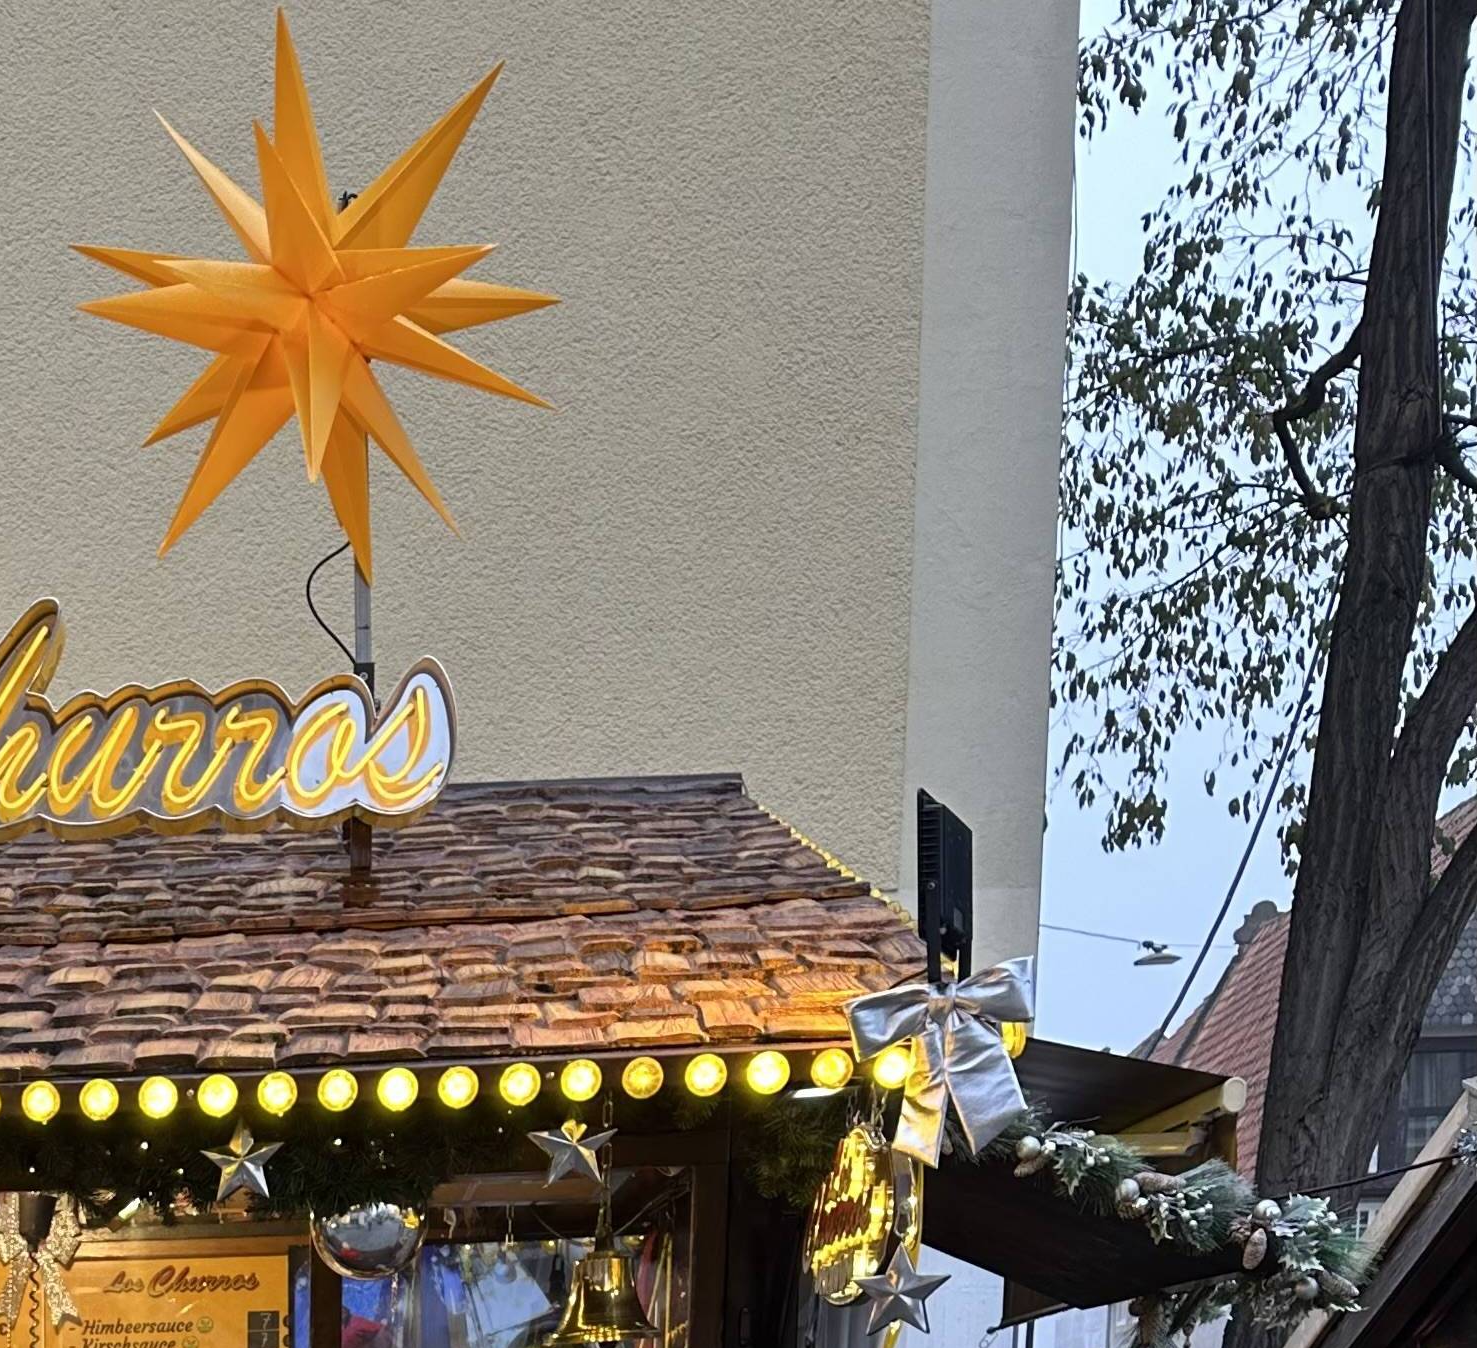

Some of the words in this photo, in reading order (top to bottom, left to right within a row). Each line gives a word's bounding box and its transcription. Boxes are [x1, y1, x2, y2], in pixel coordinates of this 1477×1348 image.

[103, 1270, 145, 1293] Los
[147, 1264, 260, 1298] Churros
[81, 1319, 194, 1336] Himbeersauce
